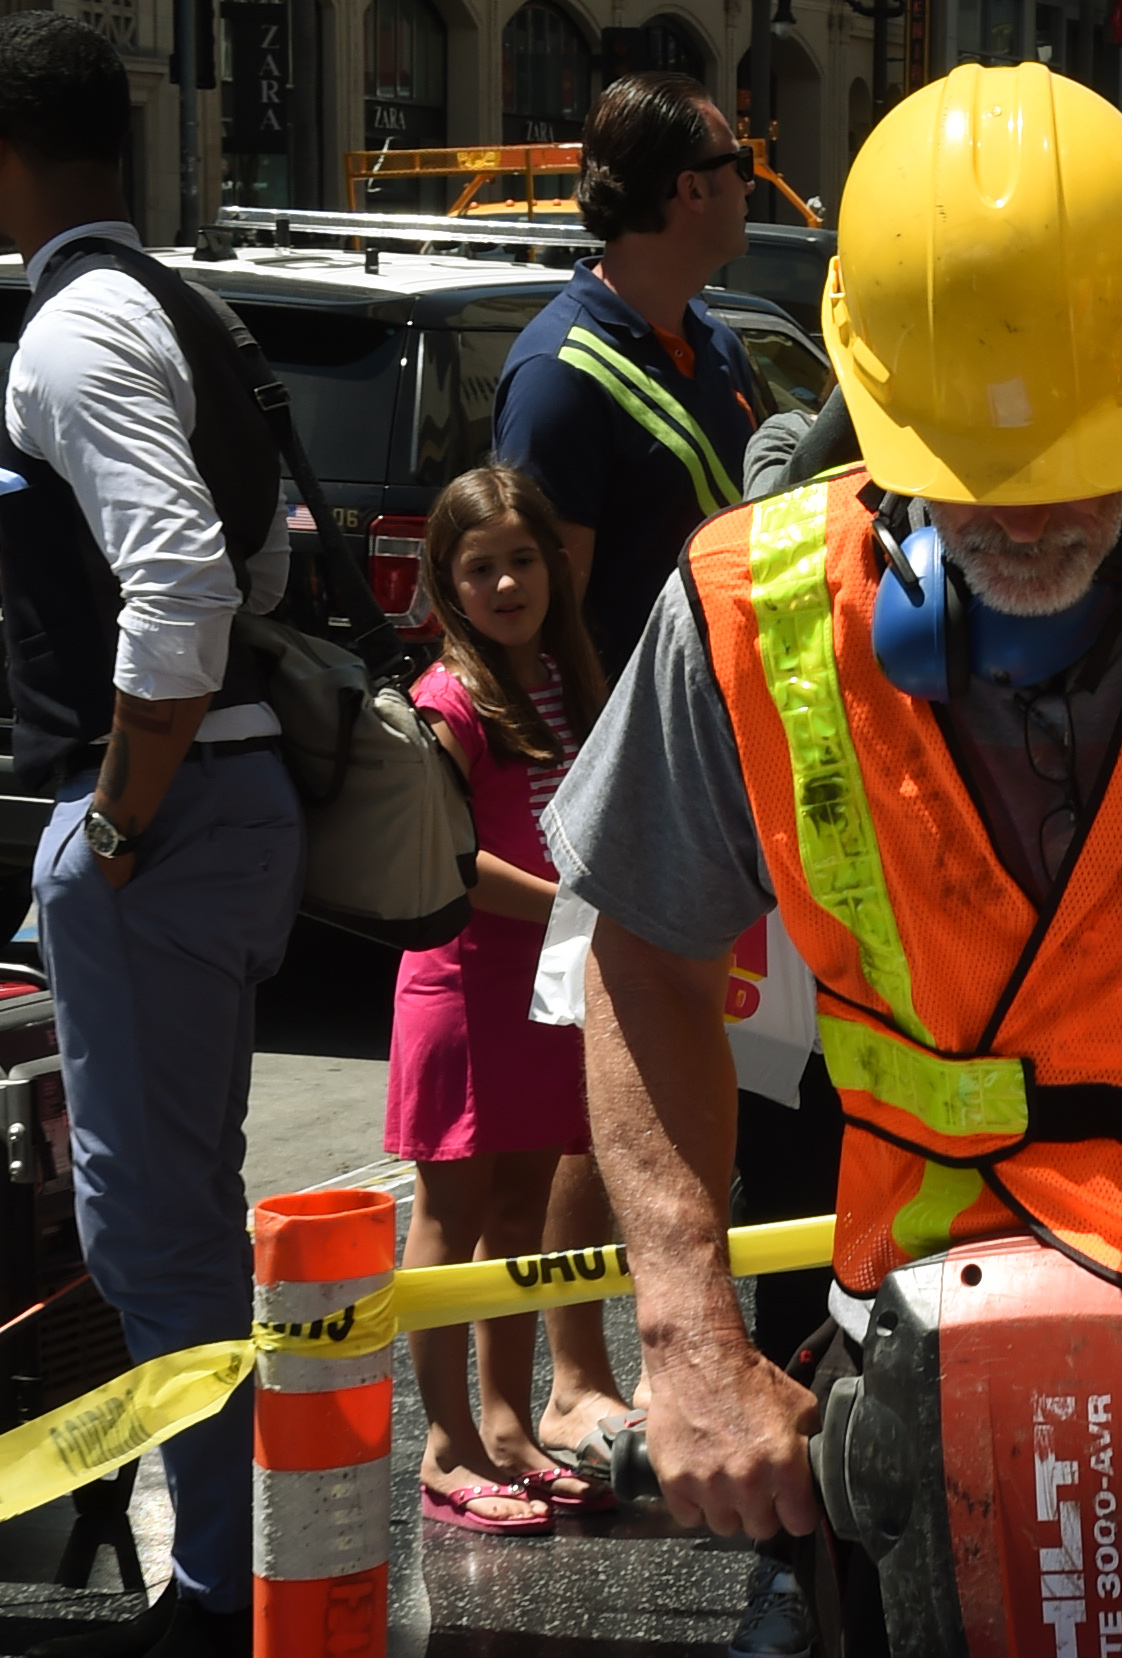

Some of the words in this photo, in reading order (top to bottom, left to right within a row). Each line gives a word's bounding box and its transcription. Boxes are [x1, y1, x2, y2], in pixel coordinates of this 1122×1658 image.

[259, 24, 282, 130] ZARA
[374, 106, 406, 130] ZARA
[526, 120, 554, 142] ZARA
[1087, 1393, 1122, 1599] 3000-AVR
